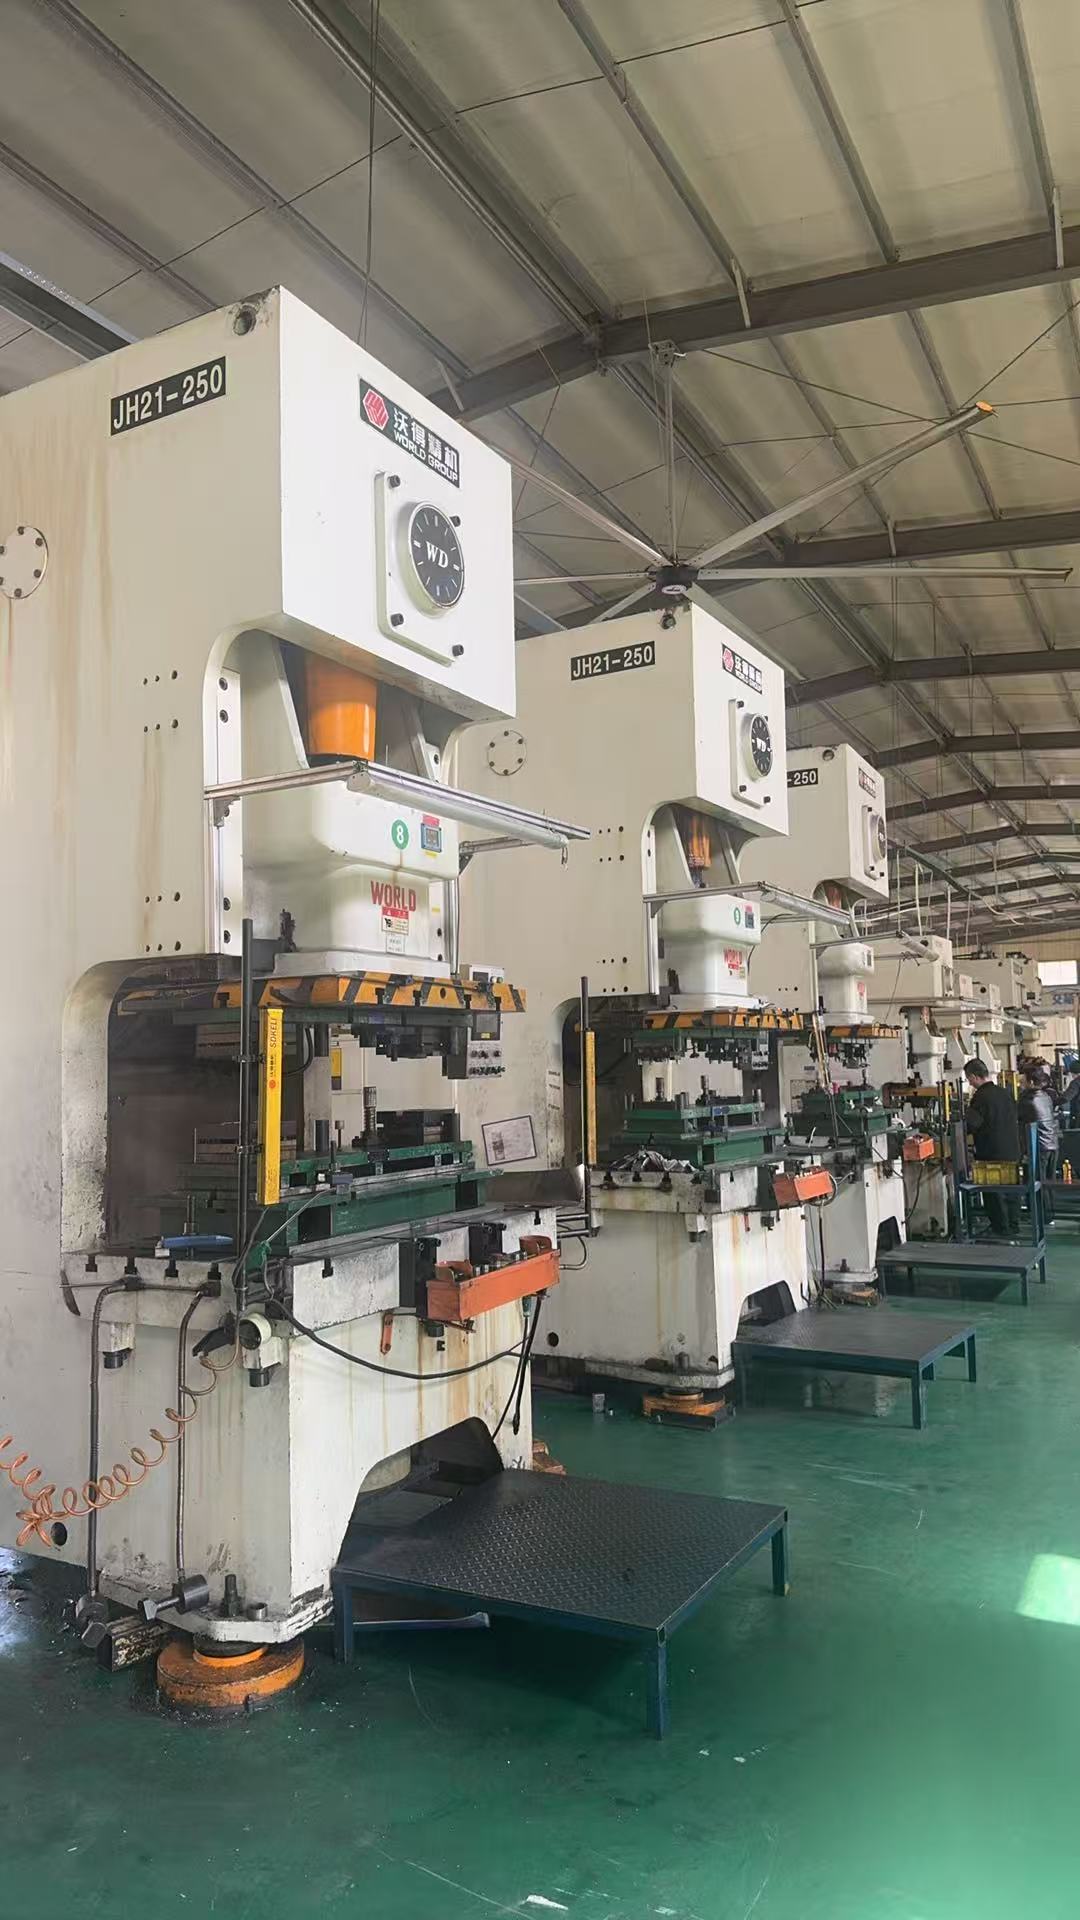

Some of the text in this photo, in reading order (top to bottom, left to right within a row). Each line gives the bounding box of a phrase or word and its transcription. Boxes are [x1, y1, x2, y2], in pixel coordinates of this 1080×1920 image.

[113, 364, 223, 429] JH21-250
[393, 429, 458, 482] WORLD GROUP
[426, 541, 448, 568] WD
[573, 645, 653, 678] JH21-250
[787, 770, 817, 785] -250
[396, 824, 404, 844] 8
[370, 881, 416, 912] WORLD
